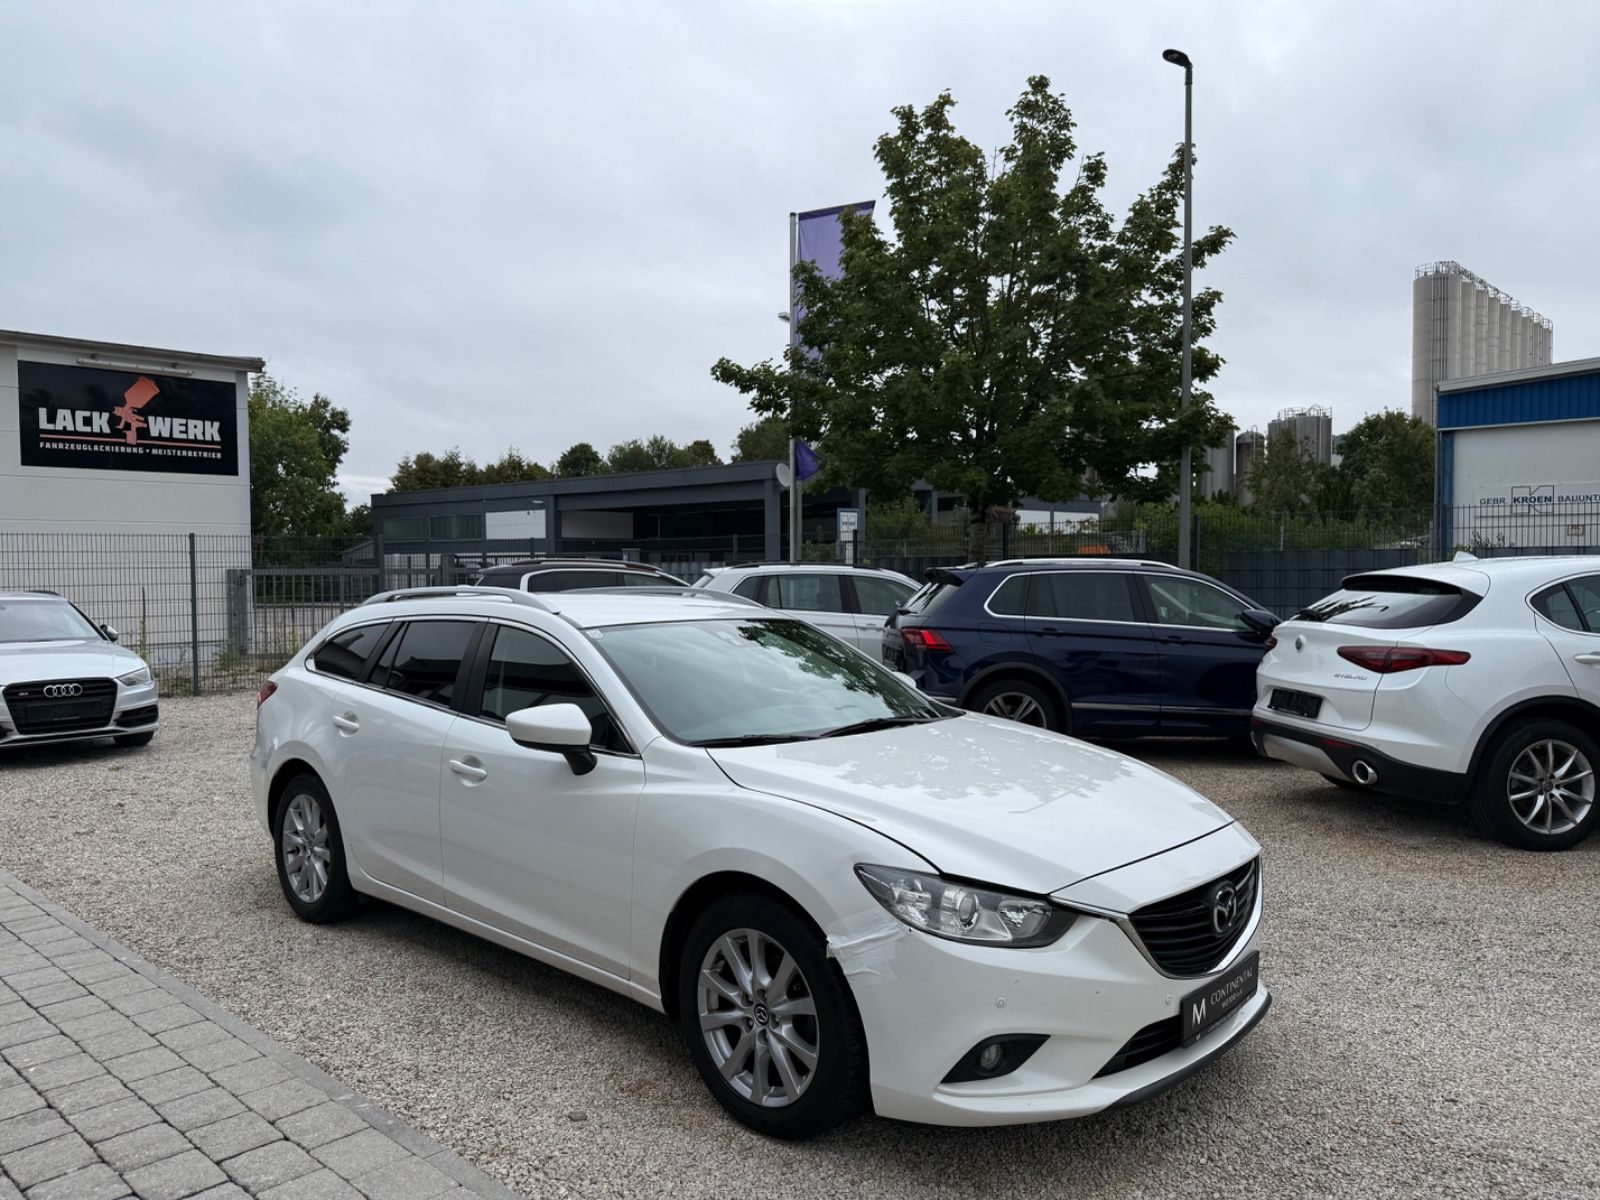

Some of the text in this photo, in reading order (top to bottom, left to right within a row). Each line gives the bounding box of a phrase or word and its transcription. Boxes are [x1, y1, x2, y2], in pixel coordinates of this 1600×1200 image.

[38, 407, 222, 442] LACK WERK
[39, 442, 222, 459] FAHRZEUGLACKIERUNG MEISTERBETRIEB
[1513, 495, 1552, 504] KROEN
[1192, 998, 1207, 1028] M
